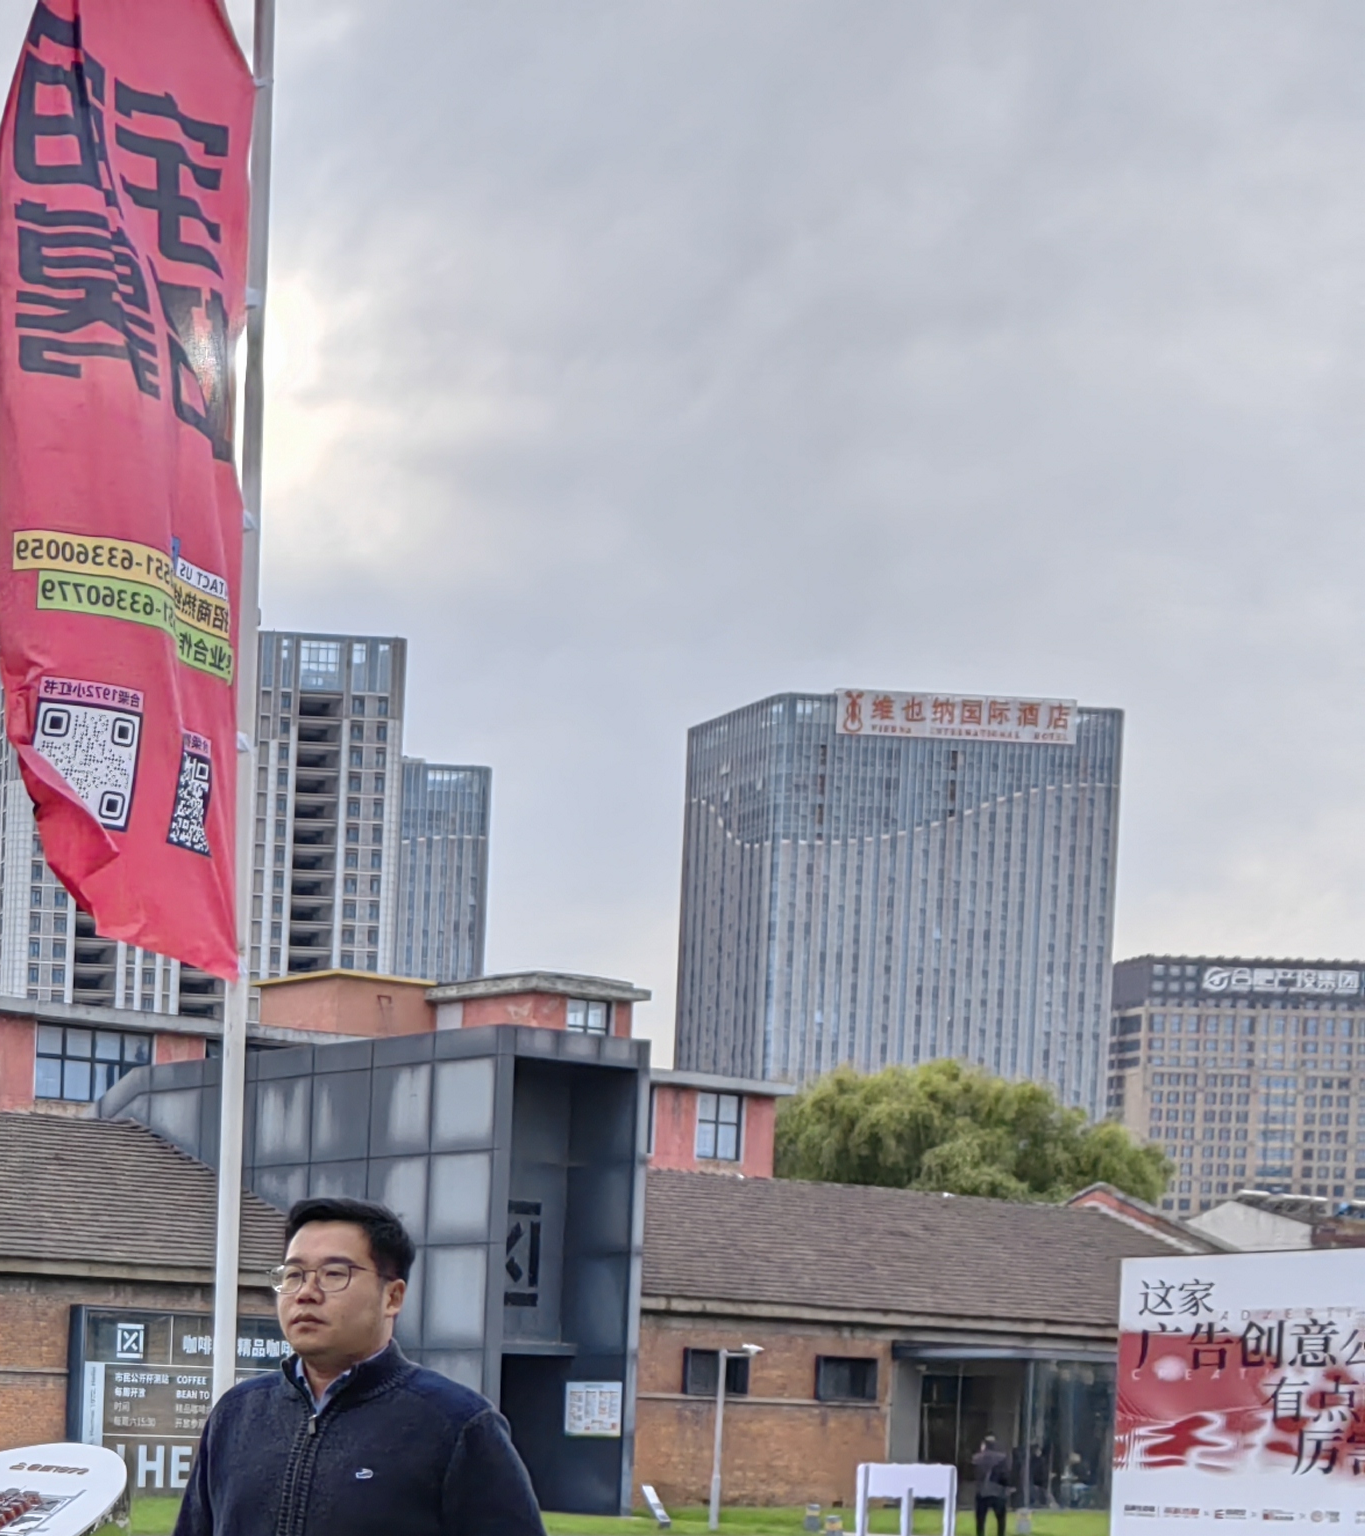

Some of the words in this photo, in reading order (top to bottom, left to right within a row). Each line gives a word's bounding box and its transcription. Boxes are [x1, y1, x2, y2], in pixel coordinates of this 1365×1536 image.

[871, 695, 1072, 730] 维也纳国际酒店
[871, 723, 912, 734] VIENNA
[930, 727, 1021, 740] INTERNATIONAL
[1034, 732, 1068, 742] HOTEL
[1231, 967, 1360, 991] 合肥产投集团
[1138, 1280, 1215, 1317] 这家
[176, 1375, 207, 1386] COFFEE
[176, 1389, 196, 1399] BEAN
[199, 1390, 210, 1400] TO
[1262, 1376, 1360, 1423] 有点
